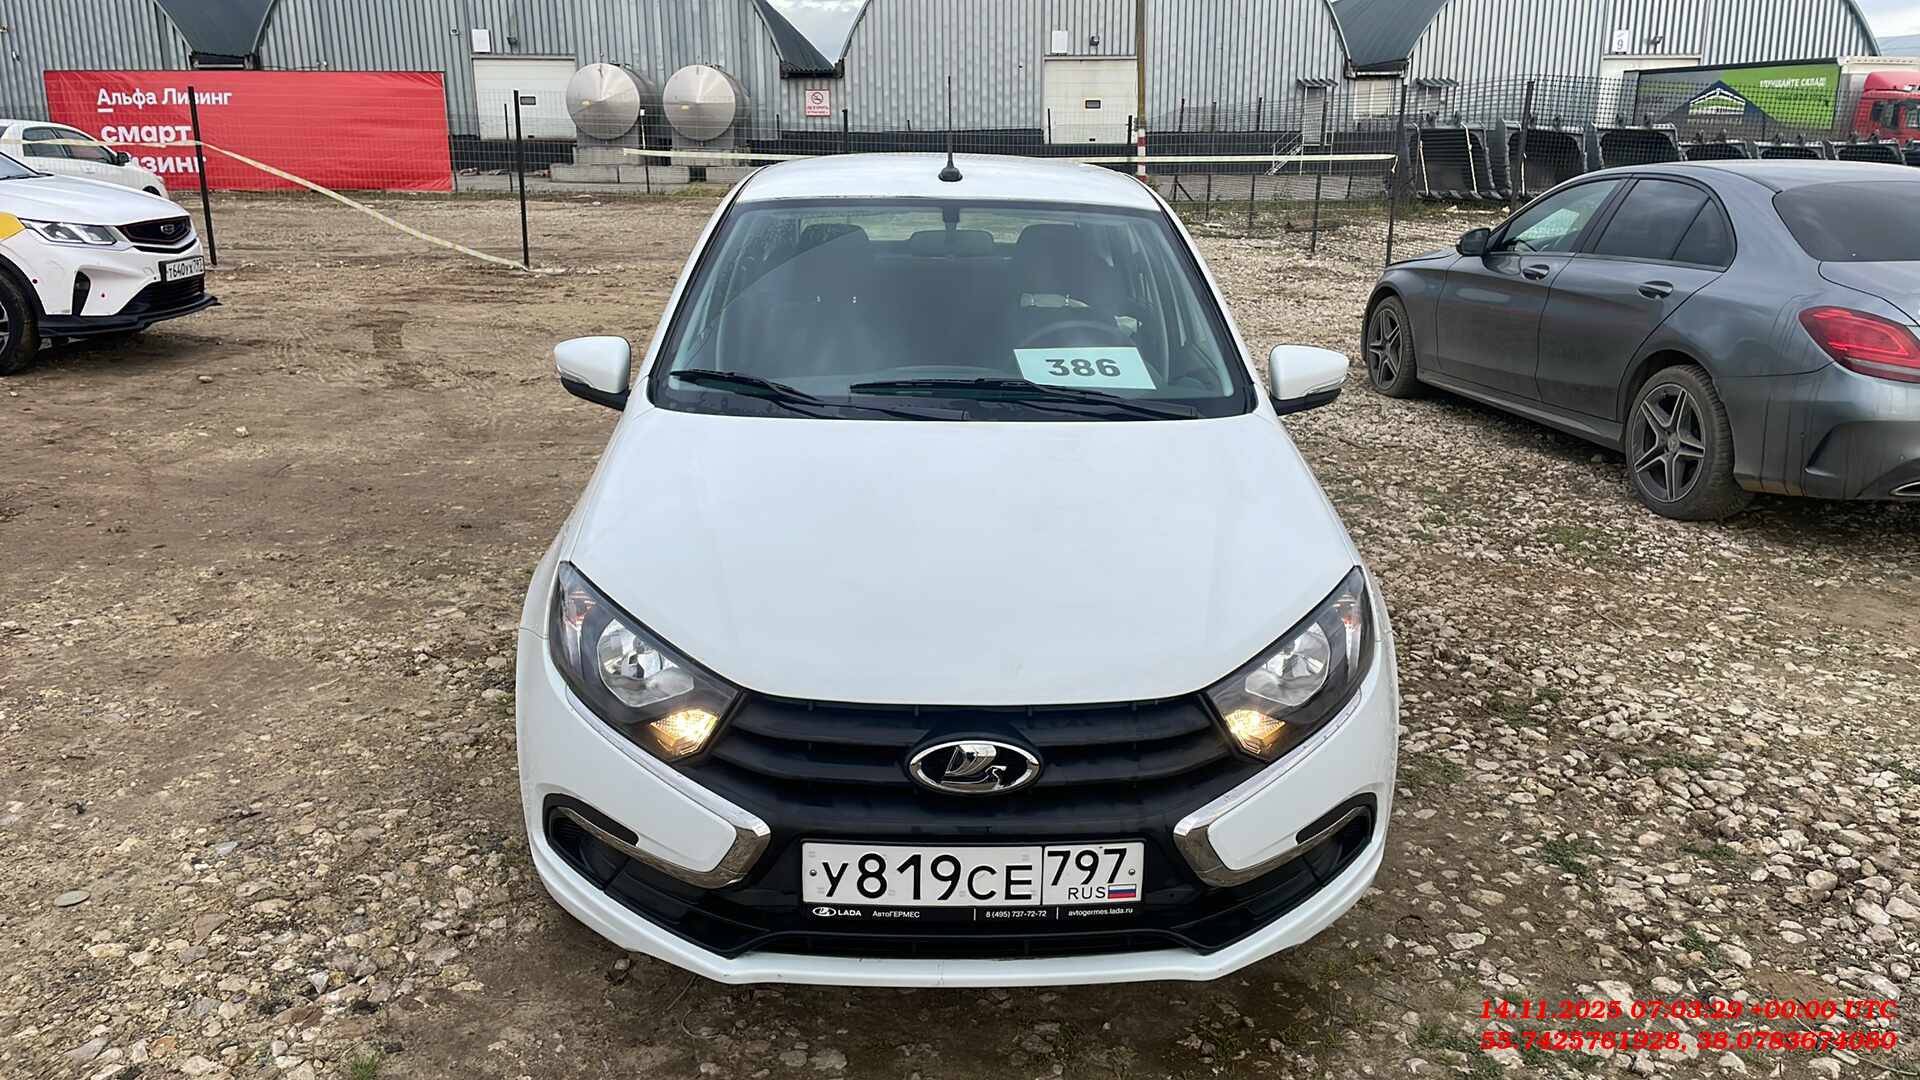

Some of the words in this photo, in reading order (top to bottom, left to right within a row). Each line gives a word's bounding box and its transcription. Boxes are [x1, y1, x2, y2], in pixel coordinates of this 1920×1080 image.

[97, 87, 157, 109] Альфа
[101, 125, 192, 145] смарт
[1045, 358, 1121, 377] 386
[822, 852, 1033, 901] У819СЕ
[1047, 848, 1127, 886] 797
[1067, 886, 1106, 900] RUS
[838, 909, 862, 917] LADA
[872, 910, 920, 918] АвтоГЕРМЕС
[991, 910, 1011, 919] (495)
[1012, 910, 1047, 918] 737-72-72
[1068, 907, 1134, 917] avtogermes.lada.ru
